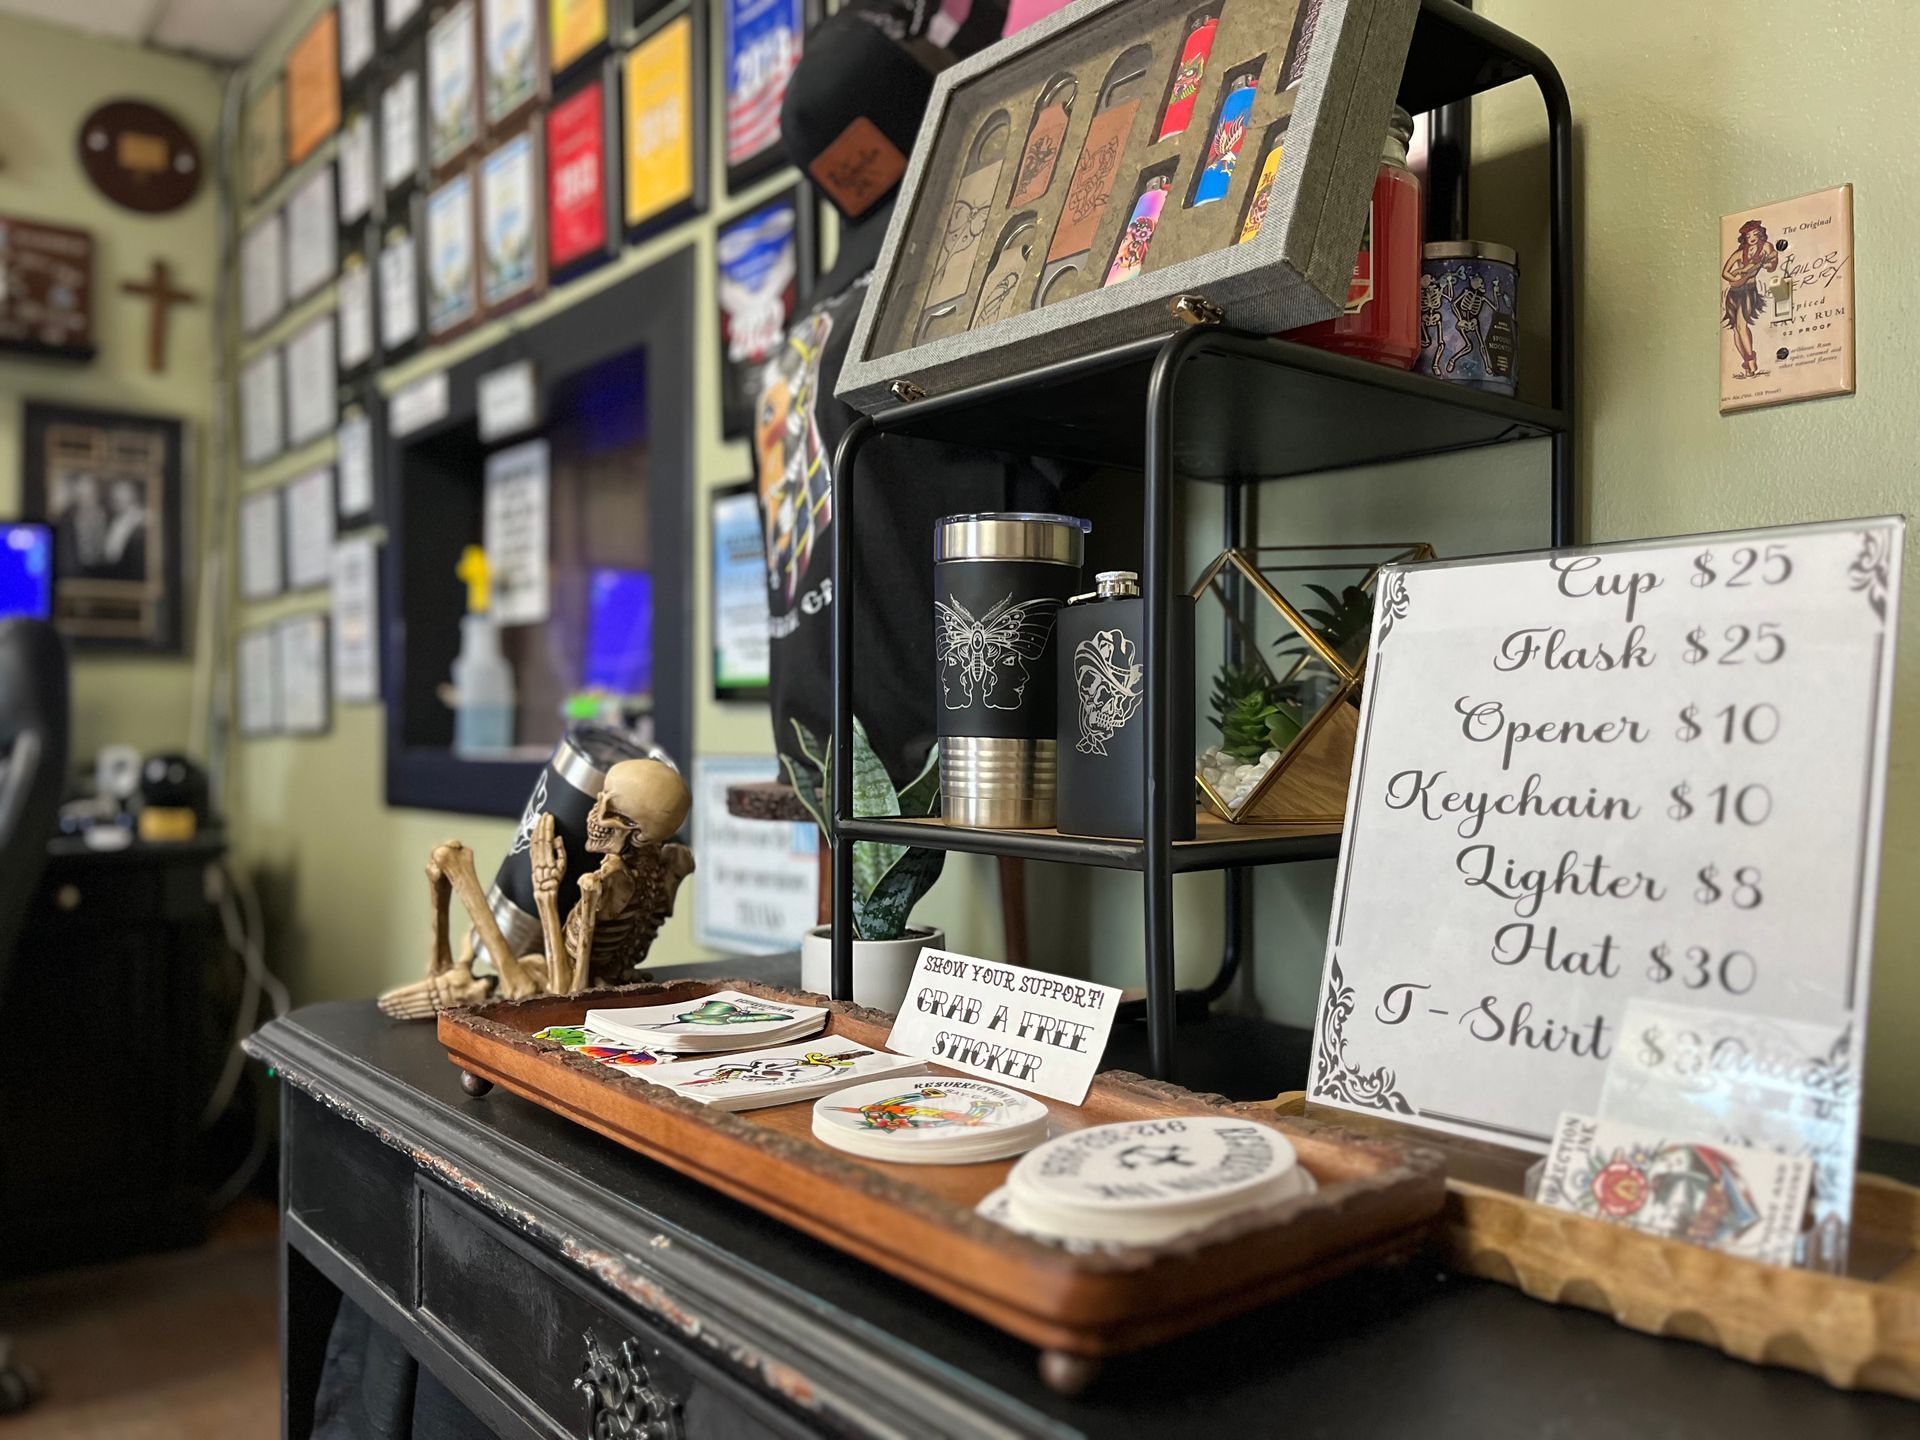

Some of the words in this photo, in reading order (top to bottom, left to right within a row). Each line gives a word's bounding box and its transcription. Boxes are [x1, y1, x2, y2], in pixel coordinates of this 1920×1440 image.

[1782, 226, 1797, 235] The
[1799, 216, 1832, 230] Original
[1780, 251, 1838, 279] SAILOR
[1791, 256, 1849, 291] ERRY
[1798, 323, 1832, 334] PROOF
[1815, 307, 1845, 320] RUM
[1549, 554, 1664, 623] Cup
[1690, 544, 1794, 589] $25
[1493, 625, 1656, 673] Flask
[1681, 622, 1787, 667] $25
[1454, 695, 1650, 770] Opener
[1675, 701, 1780, 746] $10
[1384, 769, 1641, 839] Keychain
[1666, 780, 1773, 827] $10
[1455, 844, 1667, 918] Lighter
[1694, 862, 1765, 911] $8
[923, 955, 969, 979] SHOW
[971, 964, 1016, 991] YOUR
[1018, 975, 1105, 1010] SUPPORT!
[1491, 922, 1621, 980] Hat
[1646, 941, 1758, 996] $30
[916, 987, 983, 1025] GRAB
[987, 1004, 1009, 1033] A
[1016, 1010, 1095, 1054] FREE
[932, 1031, 1043, 1083] STICKER
[914, 1081, 1010, 1099] RESURRECTION
